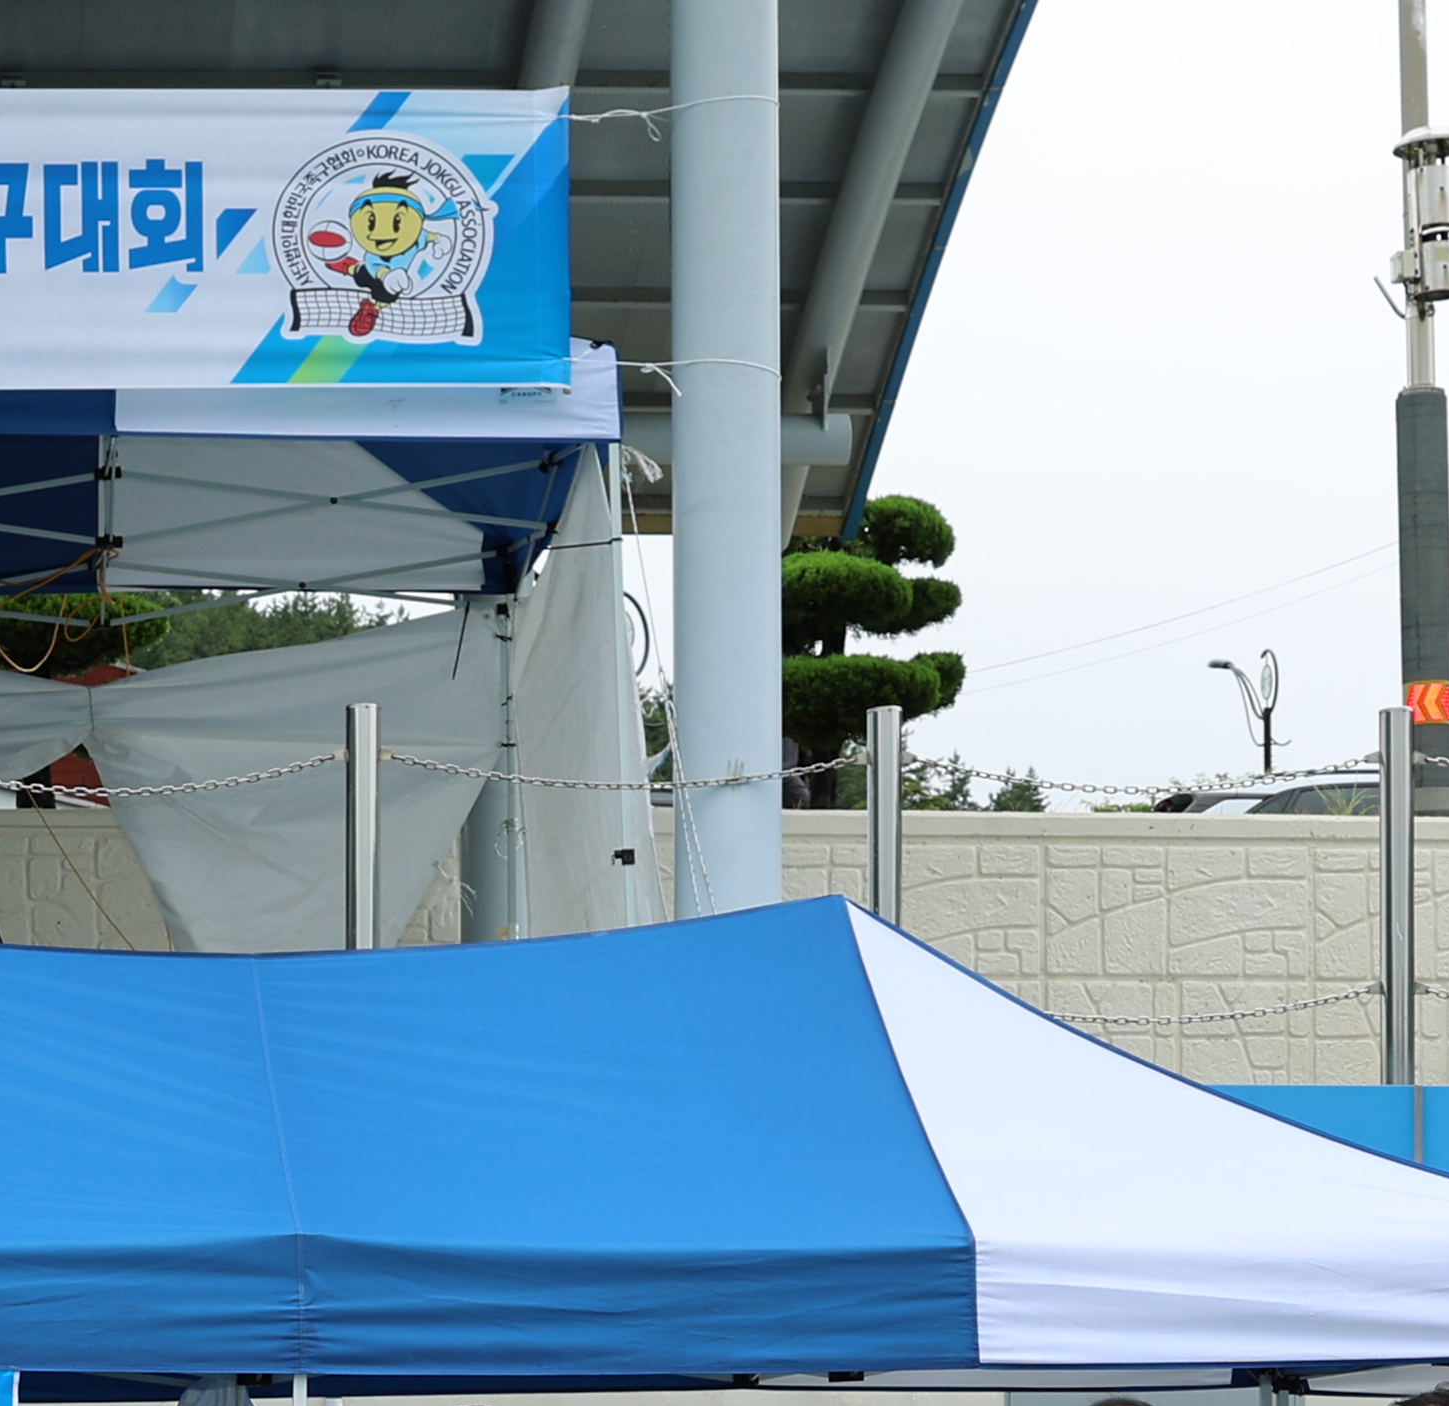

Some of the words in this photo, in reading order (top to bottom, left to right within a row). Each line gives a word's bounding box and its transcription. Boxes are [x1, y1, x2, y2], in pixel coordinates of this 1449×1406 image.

[366, 144, 420, 166] KOREA
[421, 157, 466, 199] JOKGU
[442, 199, 478, 294] ASSOCIATION
